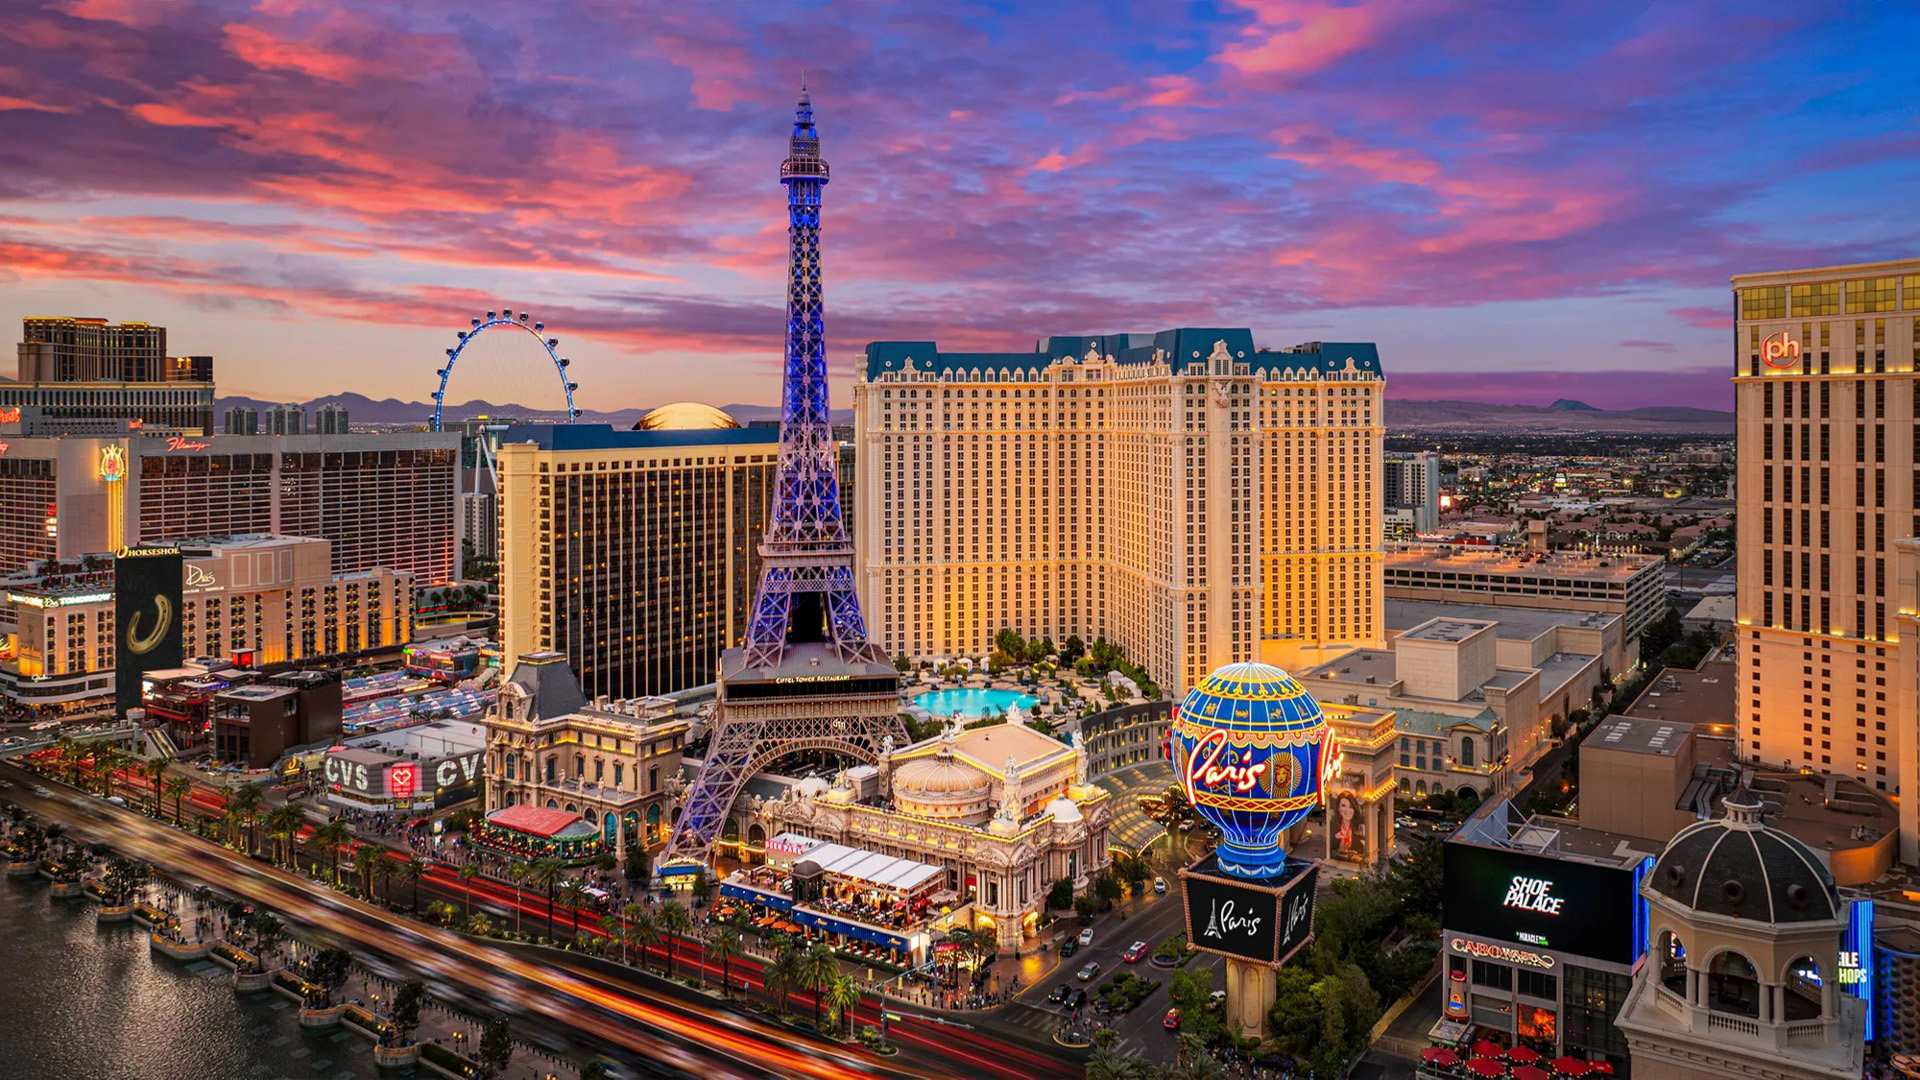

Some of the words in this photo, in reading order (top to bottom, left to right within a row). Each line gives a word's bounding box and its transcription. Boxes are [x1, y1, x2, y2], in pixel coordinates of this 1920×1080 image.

[1766, 332, 1799, 363] ph
[166, 437, 211, 452] Flamingo
[128, 547, 180, 557] HORSESHOE
[325, 757, 368, 790] CVS
[437, 753, 485, 786] CV
[1186, 729, 1265, 806] Paris
[765, 841, 783, 851] BEER
[784, 845, 804, 856] PARK
[1510, 876, 1552, 897] SHOE
[1503, 891, 1564, 914] PALACE
[1221, 900, 1262, 936] Paris
[1451, 938, 1502, 959] CABO
